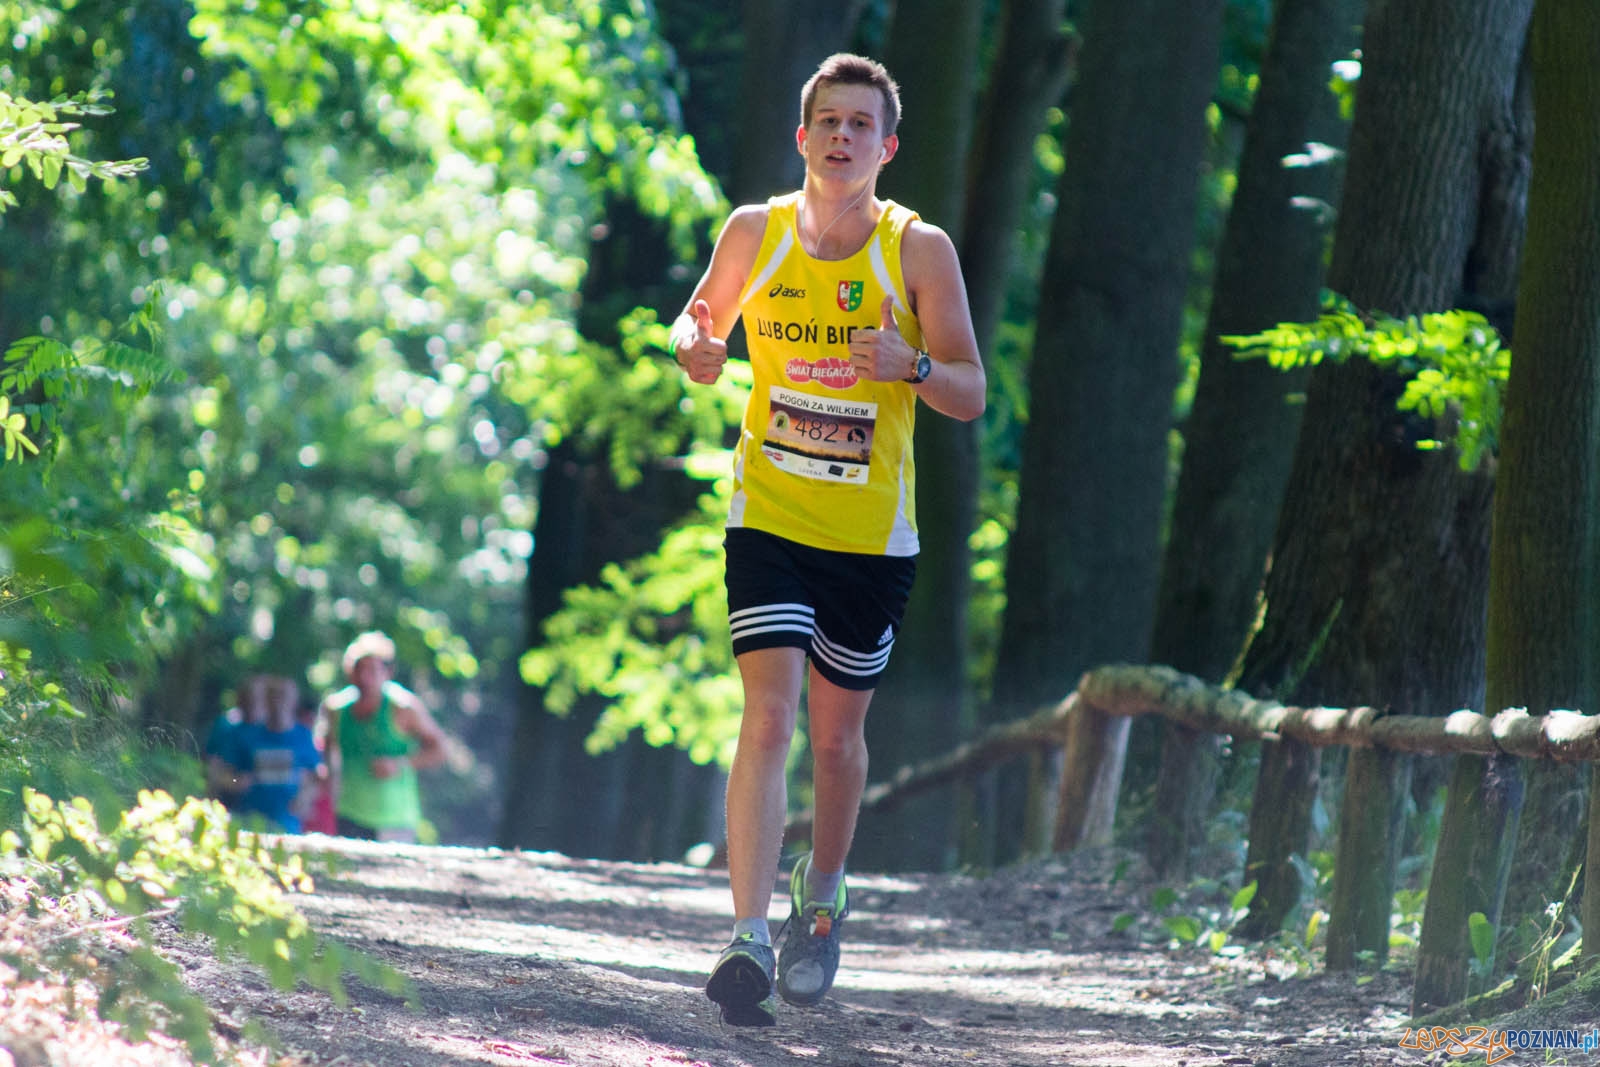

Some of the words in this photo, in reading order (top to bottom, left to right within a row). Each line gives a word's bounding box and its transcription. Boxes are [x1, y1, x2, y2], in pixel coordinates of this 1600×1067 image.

[757, 318, 818, 344] LUBOŃ
[811, 402, 824, 411] ZA
[826, 404, 869, 417] WILKIEM
[795, 417, 840, 443] 482
